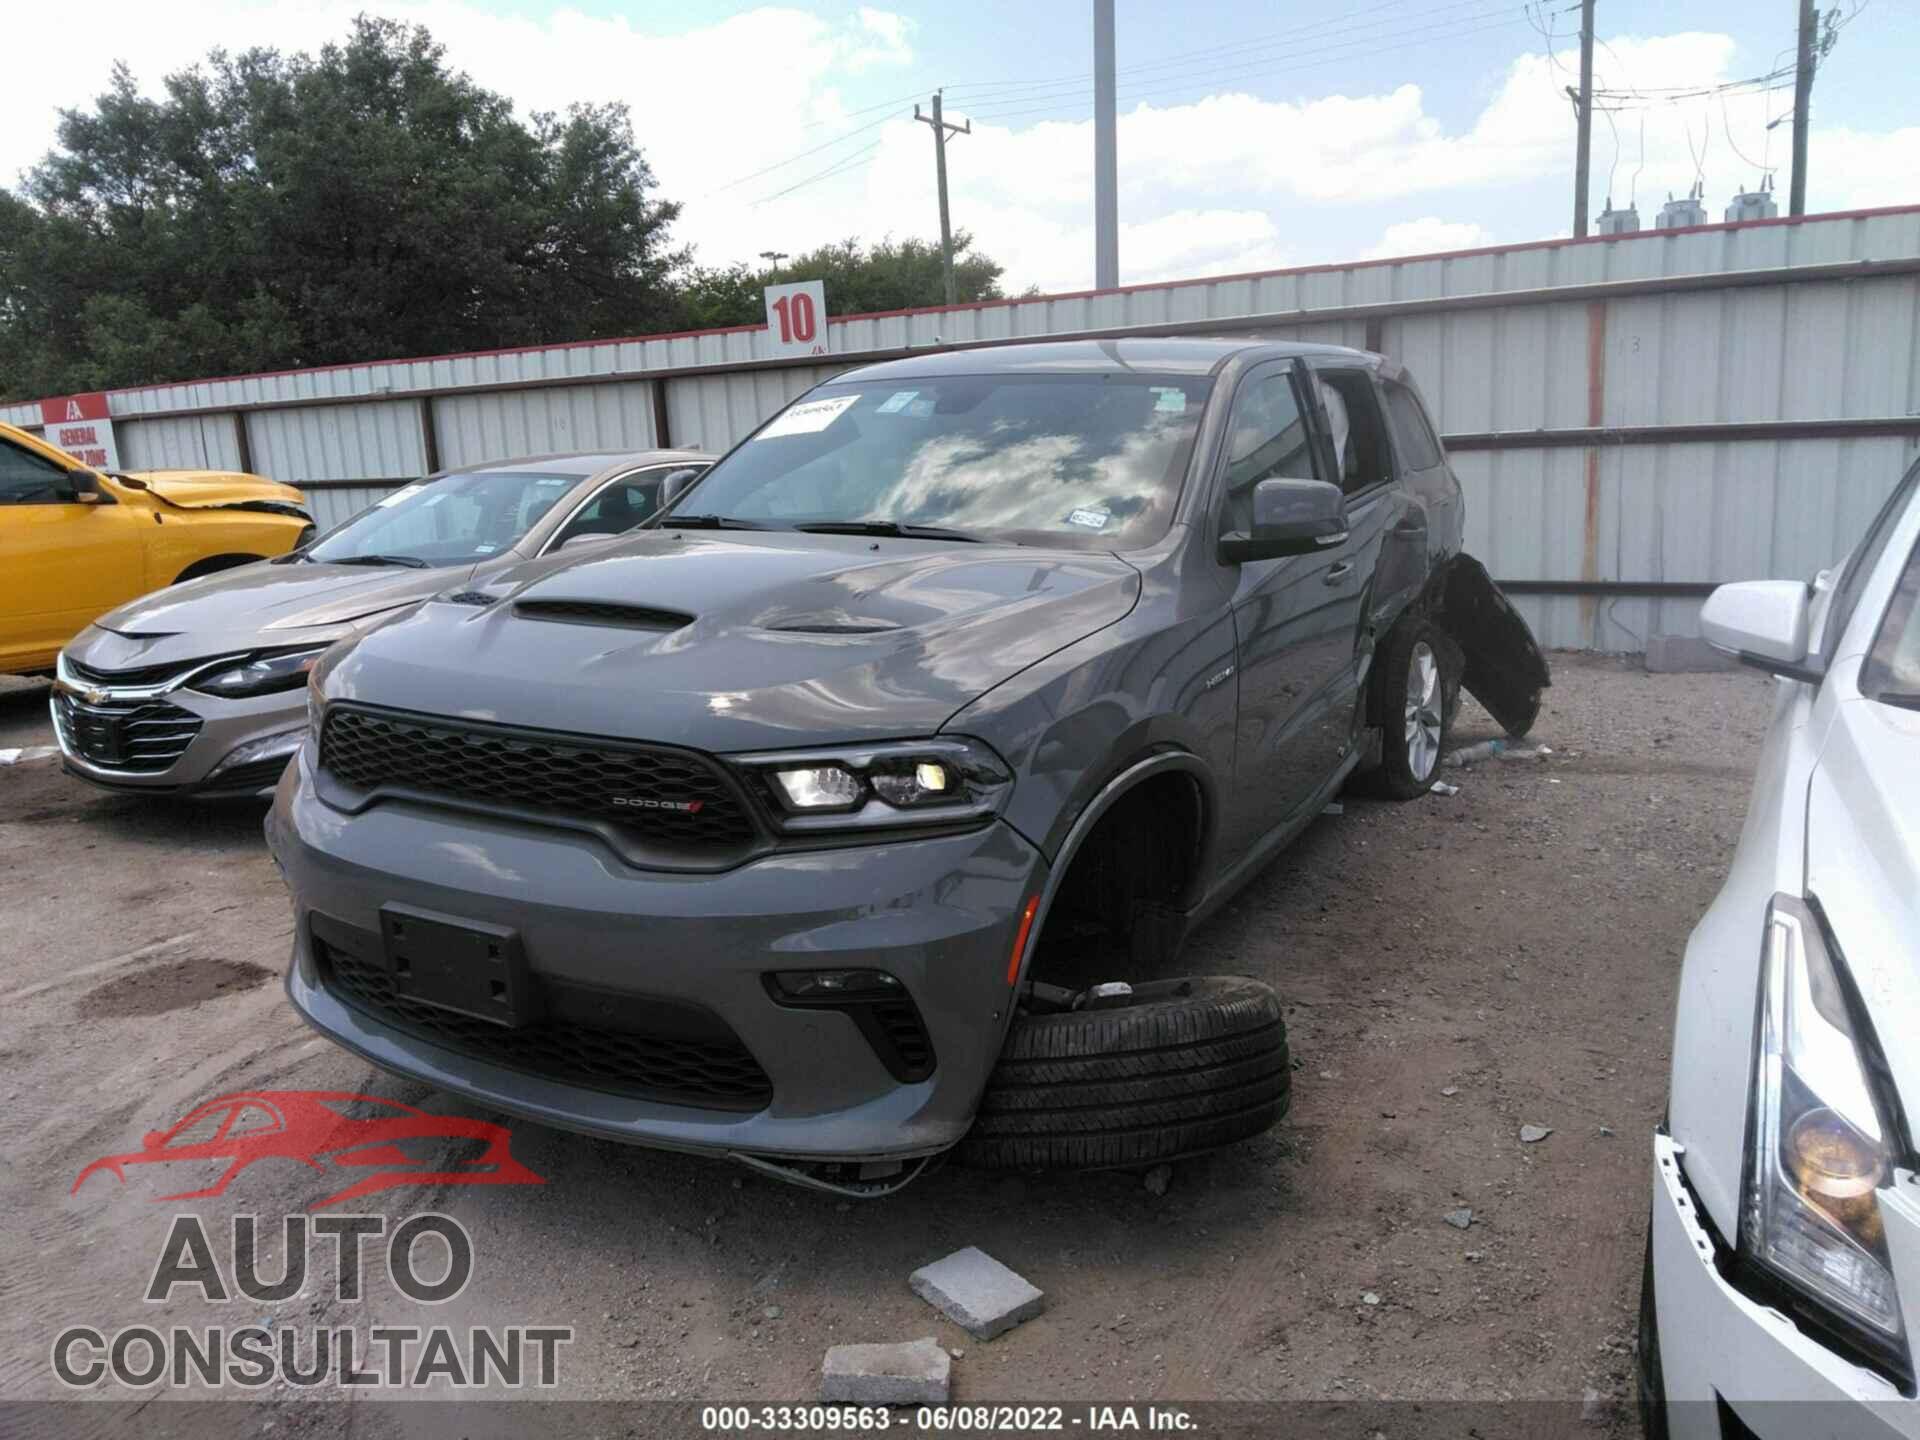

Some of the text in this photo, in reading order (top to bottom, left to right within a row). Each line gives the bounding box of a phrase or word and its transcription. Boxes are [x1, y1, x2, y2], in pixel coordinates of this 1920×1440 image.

[772, 292, 815, 342] 10
[60, 426, 98, 447] GENERAL
[85, 448, 107, 467] ZONE
[613, 797, 690, 811] DODGE
